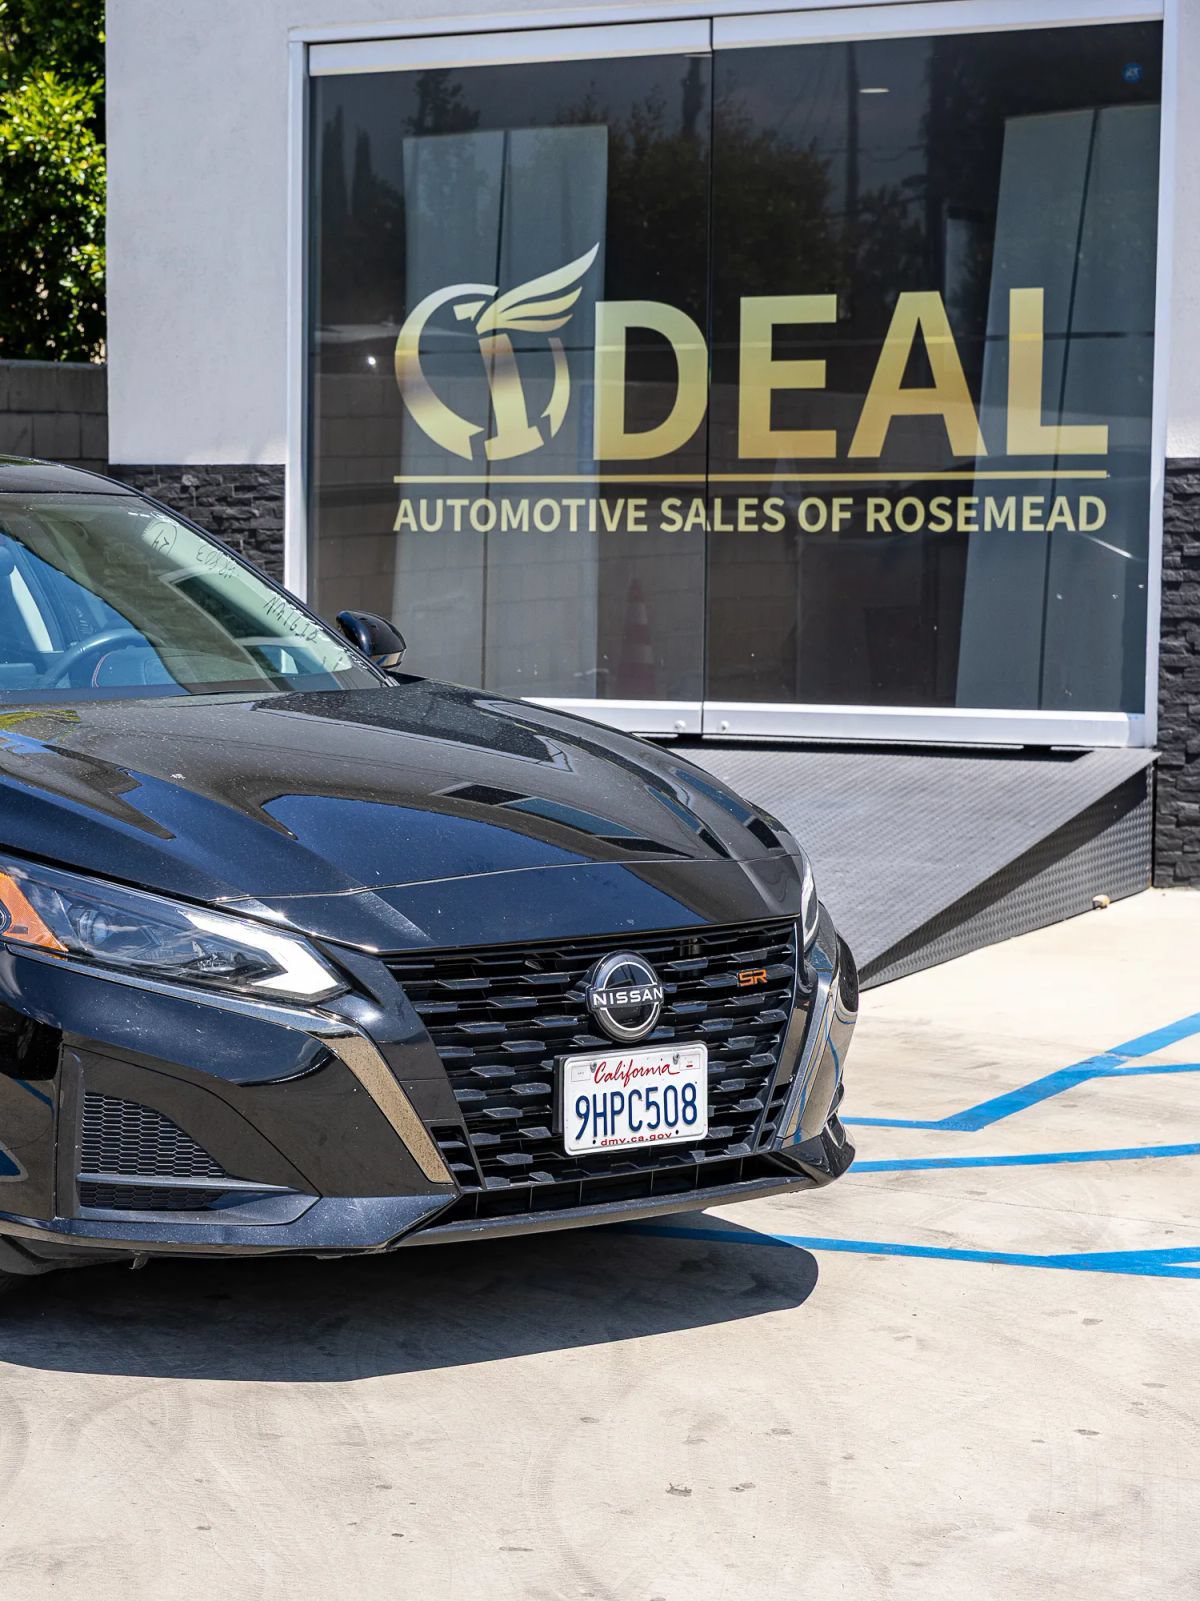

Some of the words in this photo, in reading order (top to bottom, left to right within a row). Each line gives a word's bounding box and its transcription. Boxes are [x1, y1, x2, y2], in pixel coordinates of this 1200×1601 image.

[394, 498, 647, 532] AUTOMOTIVE
[661, 498, 786, 532] SALES
[798, 497, 853, 532] OF
[867, 496, 1107, 532] ROSEMEAD
[738, 969, 767, 987] SR
[593, 986, 664, 1006] NISSAN
[594, 1059, 680, 1087] California
[575, 1083, 697, 1140] 9HPC508
[600, 1132, 672, 1146] dmv.ca.gov
